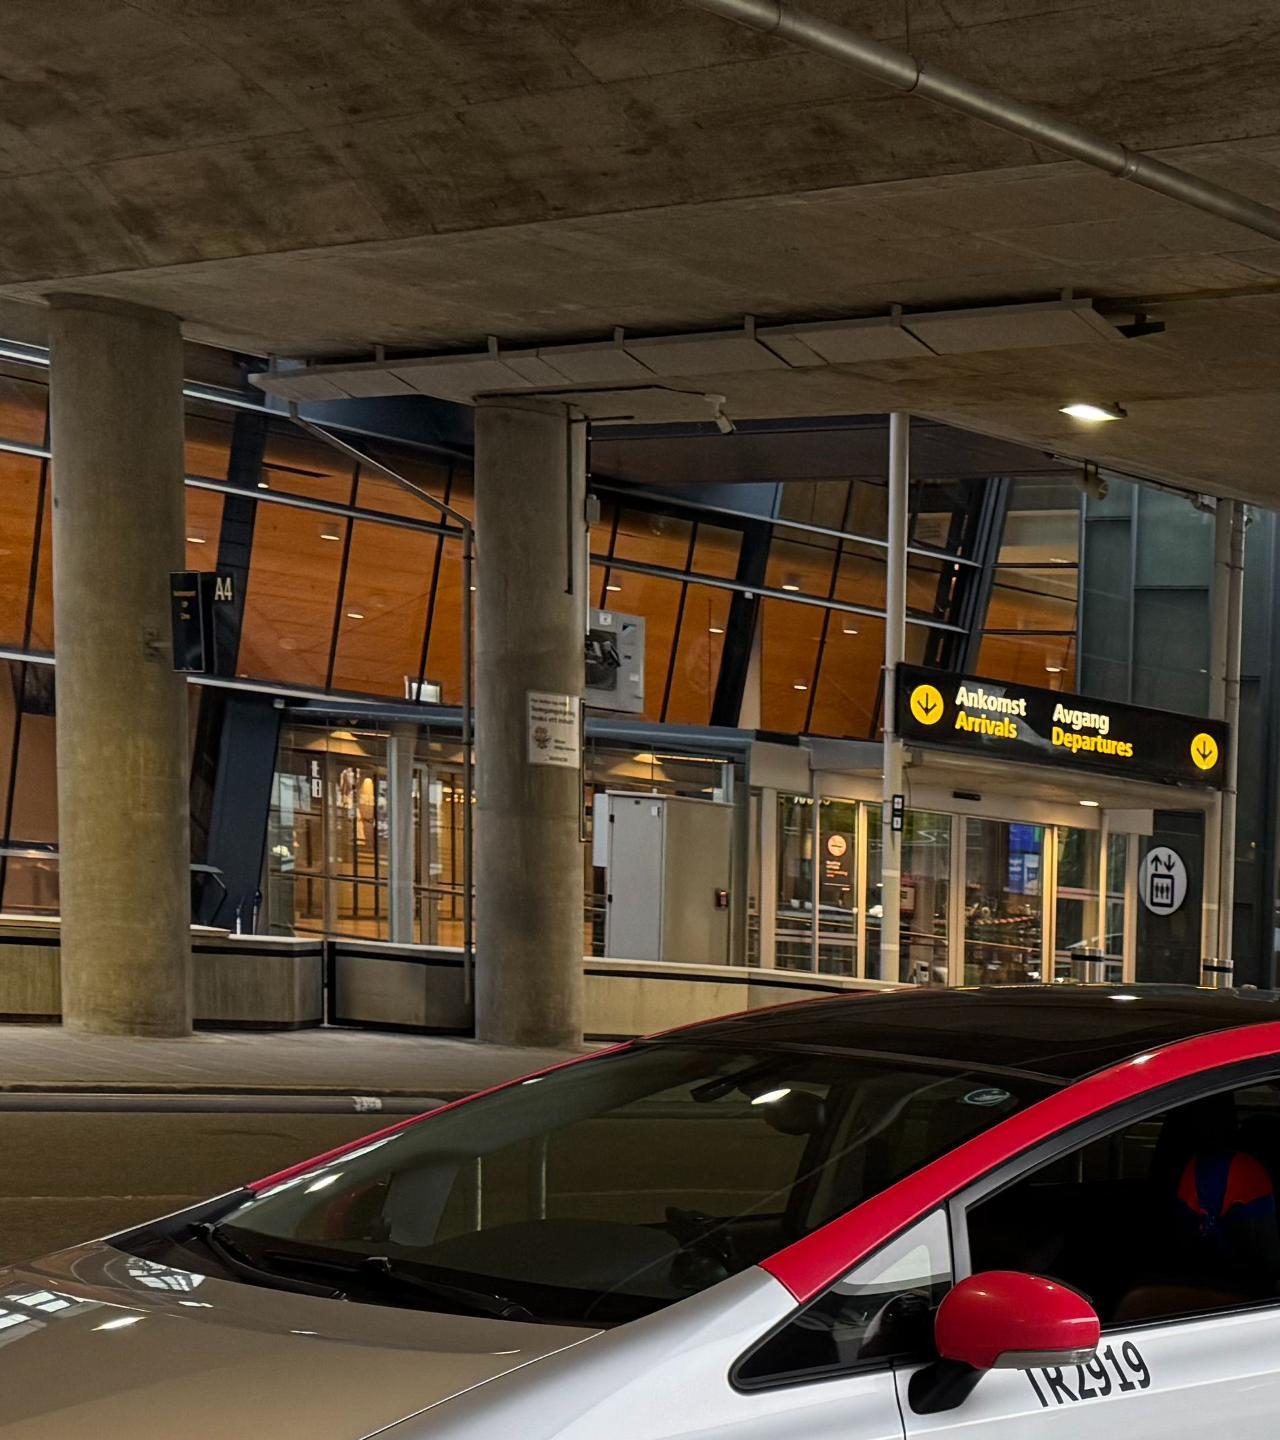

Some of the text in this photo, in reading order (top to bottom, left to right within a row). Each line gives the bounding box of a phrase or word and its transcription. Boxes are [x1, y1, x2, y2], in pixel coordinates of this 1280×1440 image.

[214, 577, 233, 600] A4
[955, 686, 1027, 716] Ankomst
[954, 711, 1018, 739] Arrivals
[1052, 703, 1110, 735] Avgang
[1051, 726, 1133, 757] Departures
